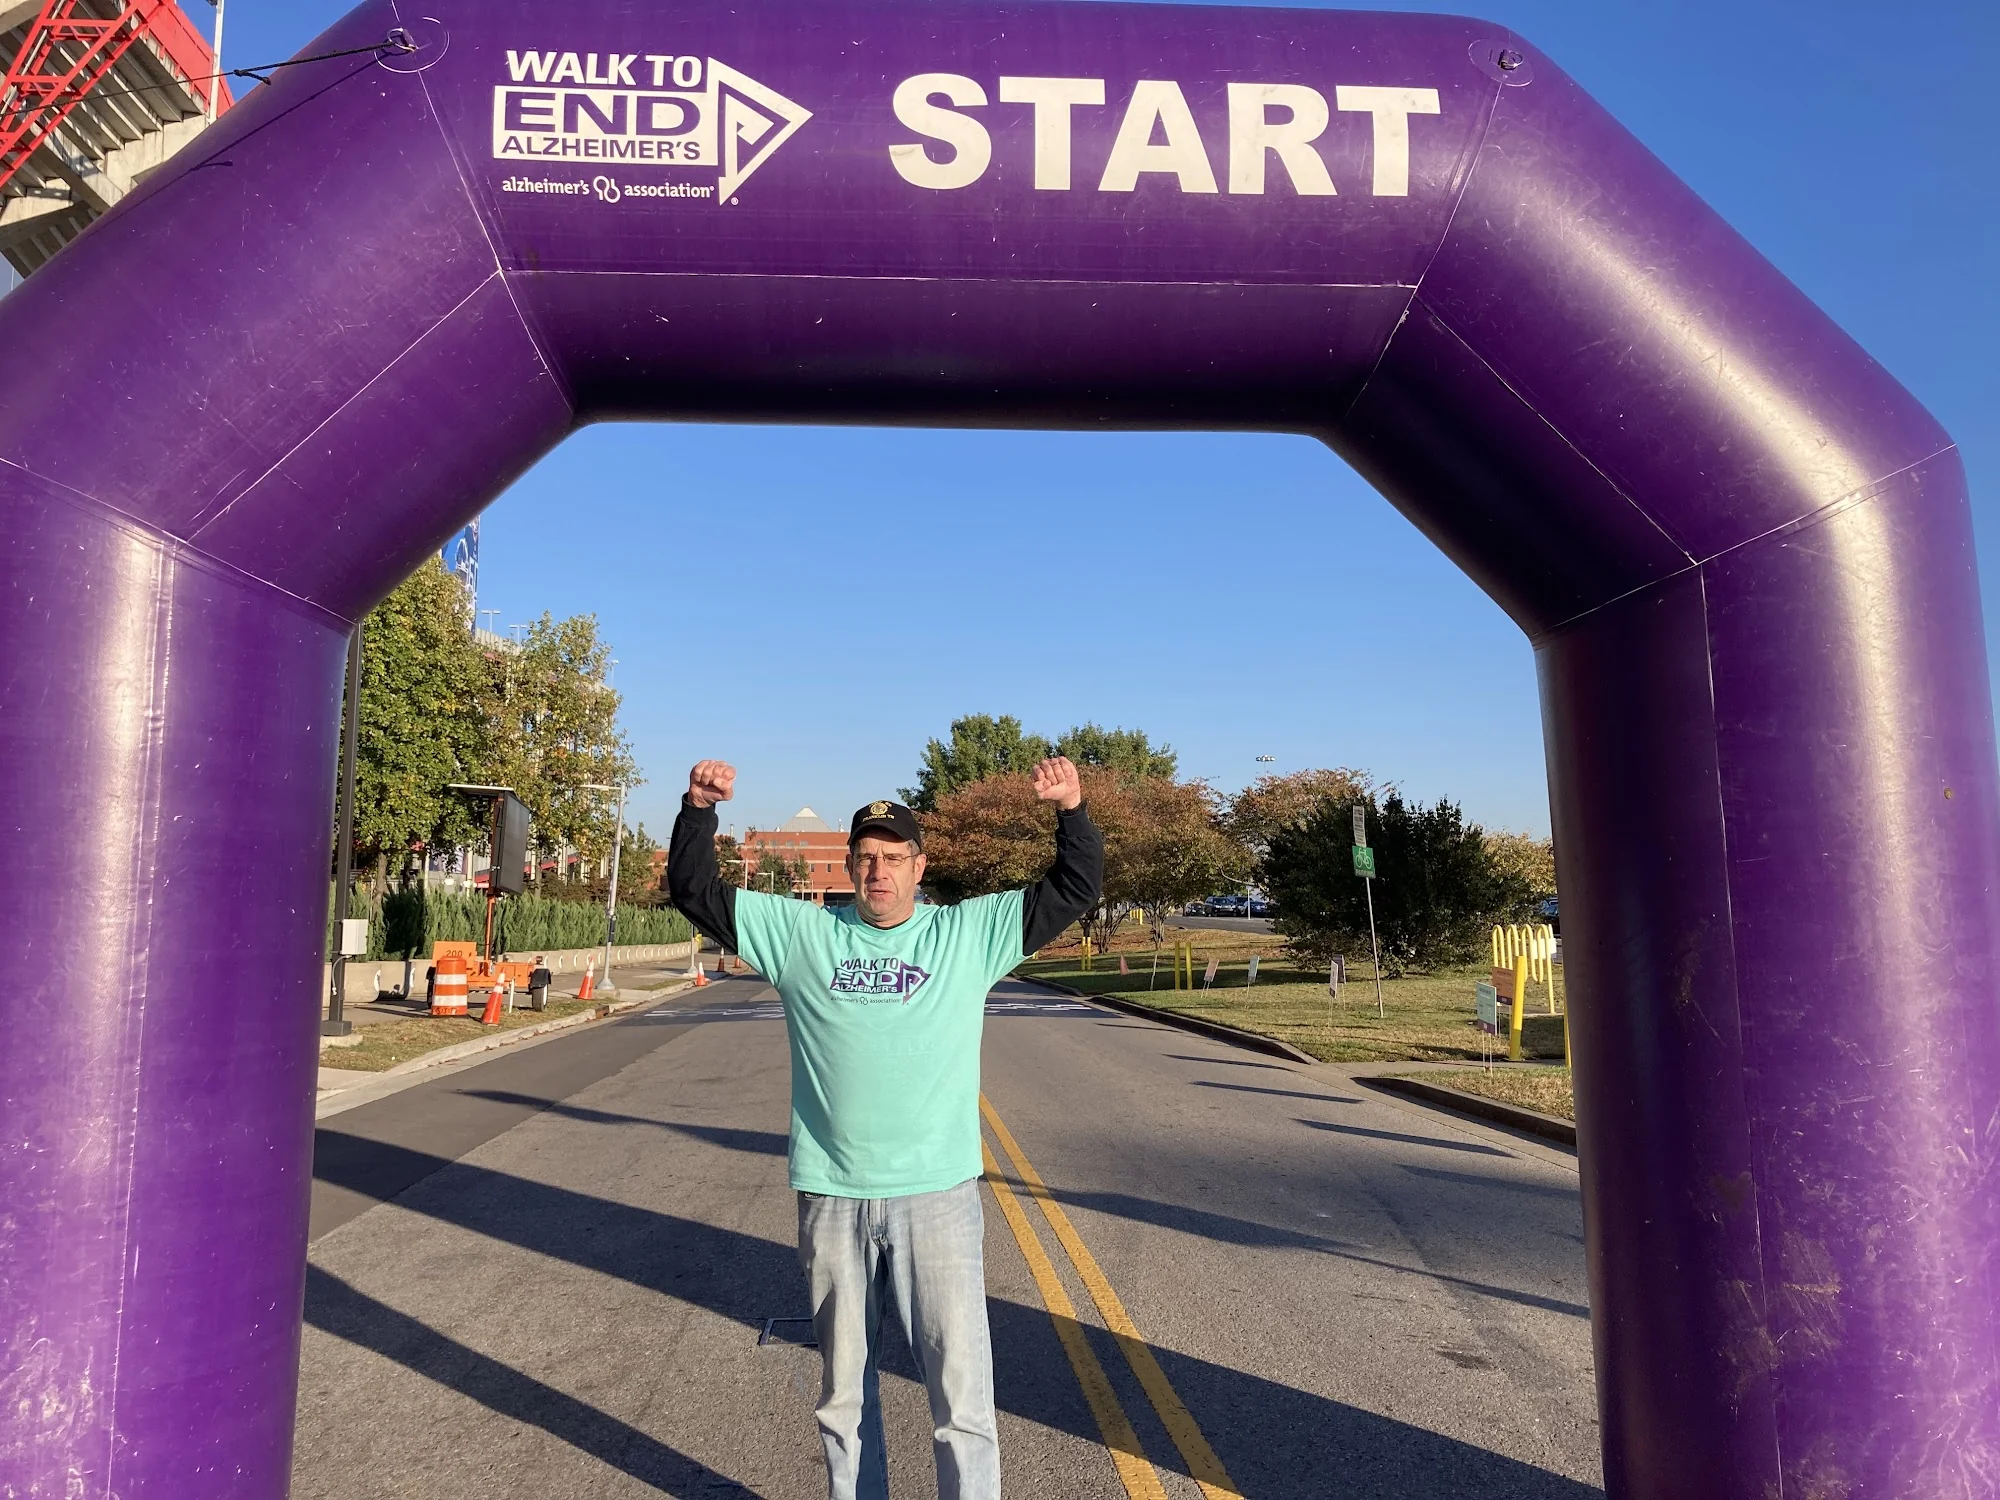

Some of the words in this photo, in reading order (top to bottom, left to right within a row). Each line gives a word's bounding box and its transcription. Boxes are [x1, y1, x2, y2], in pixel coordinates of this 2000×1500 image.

[506, 50, 638, 86] WALK
[646, 55, 703, 88] TO
[504, 91, 701, 136] END
[888, 73, 1441, 197] START
[501, 135, 701, 160] ALZHEIMER'S
[502, 176, 590, 195] alzheimer's
[840, 958, 880, 971] WALK
[881, 957, 899, 970] TO
[831, 984, 898, 993] ALZHEIMER'S
[835, 971, 899, 987] END
